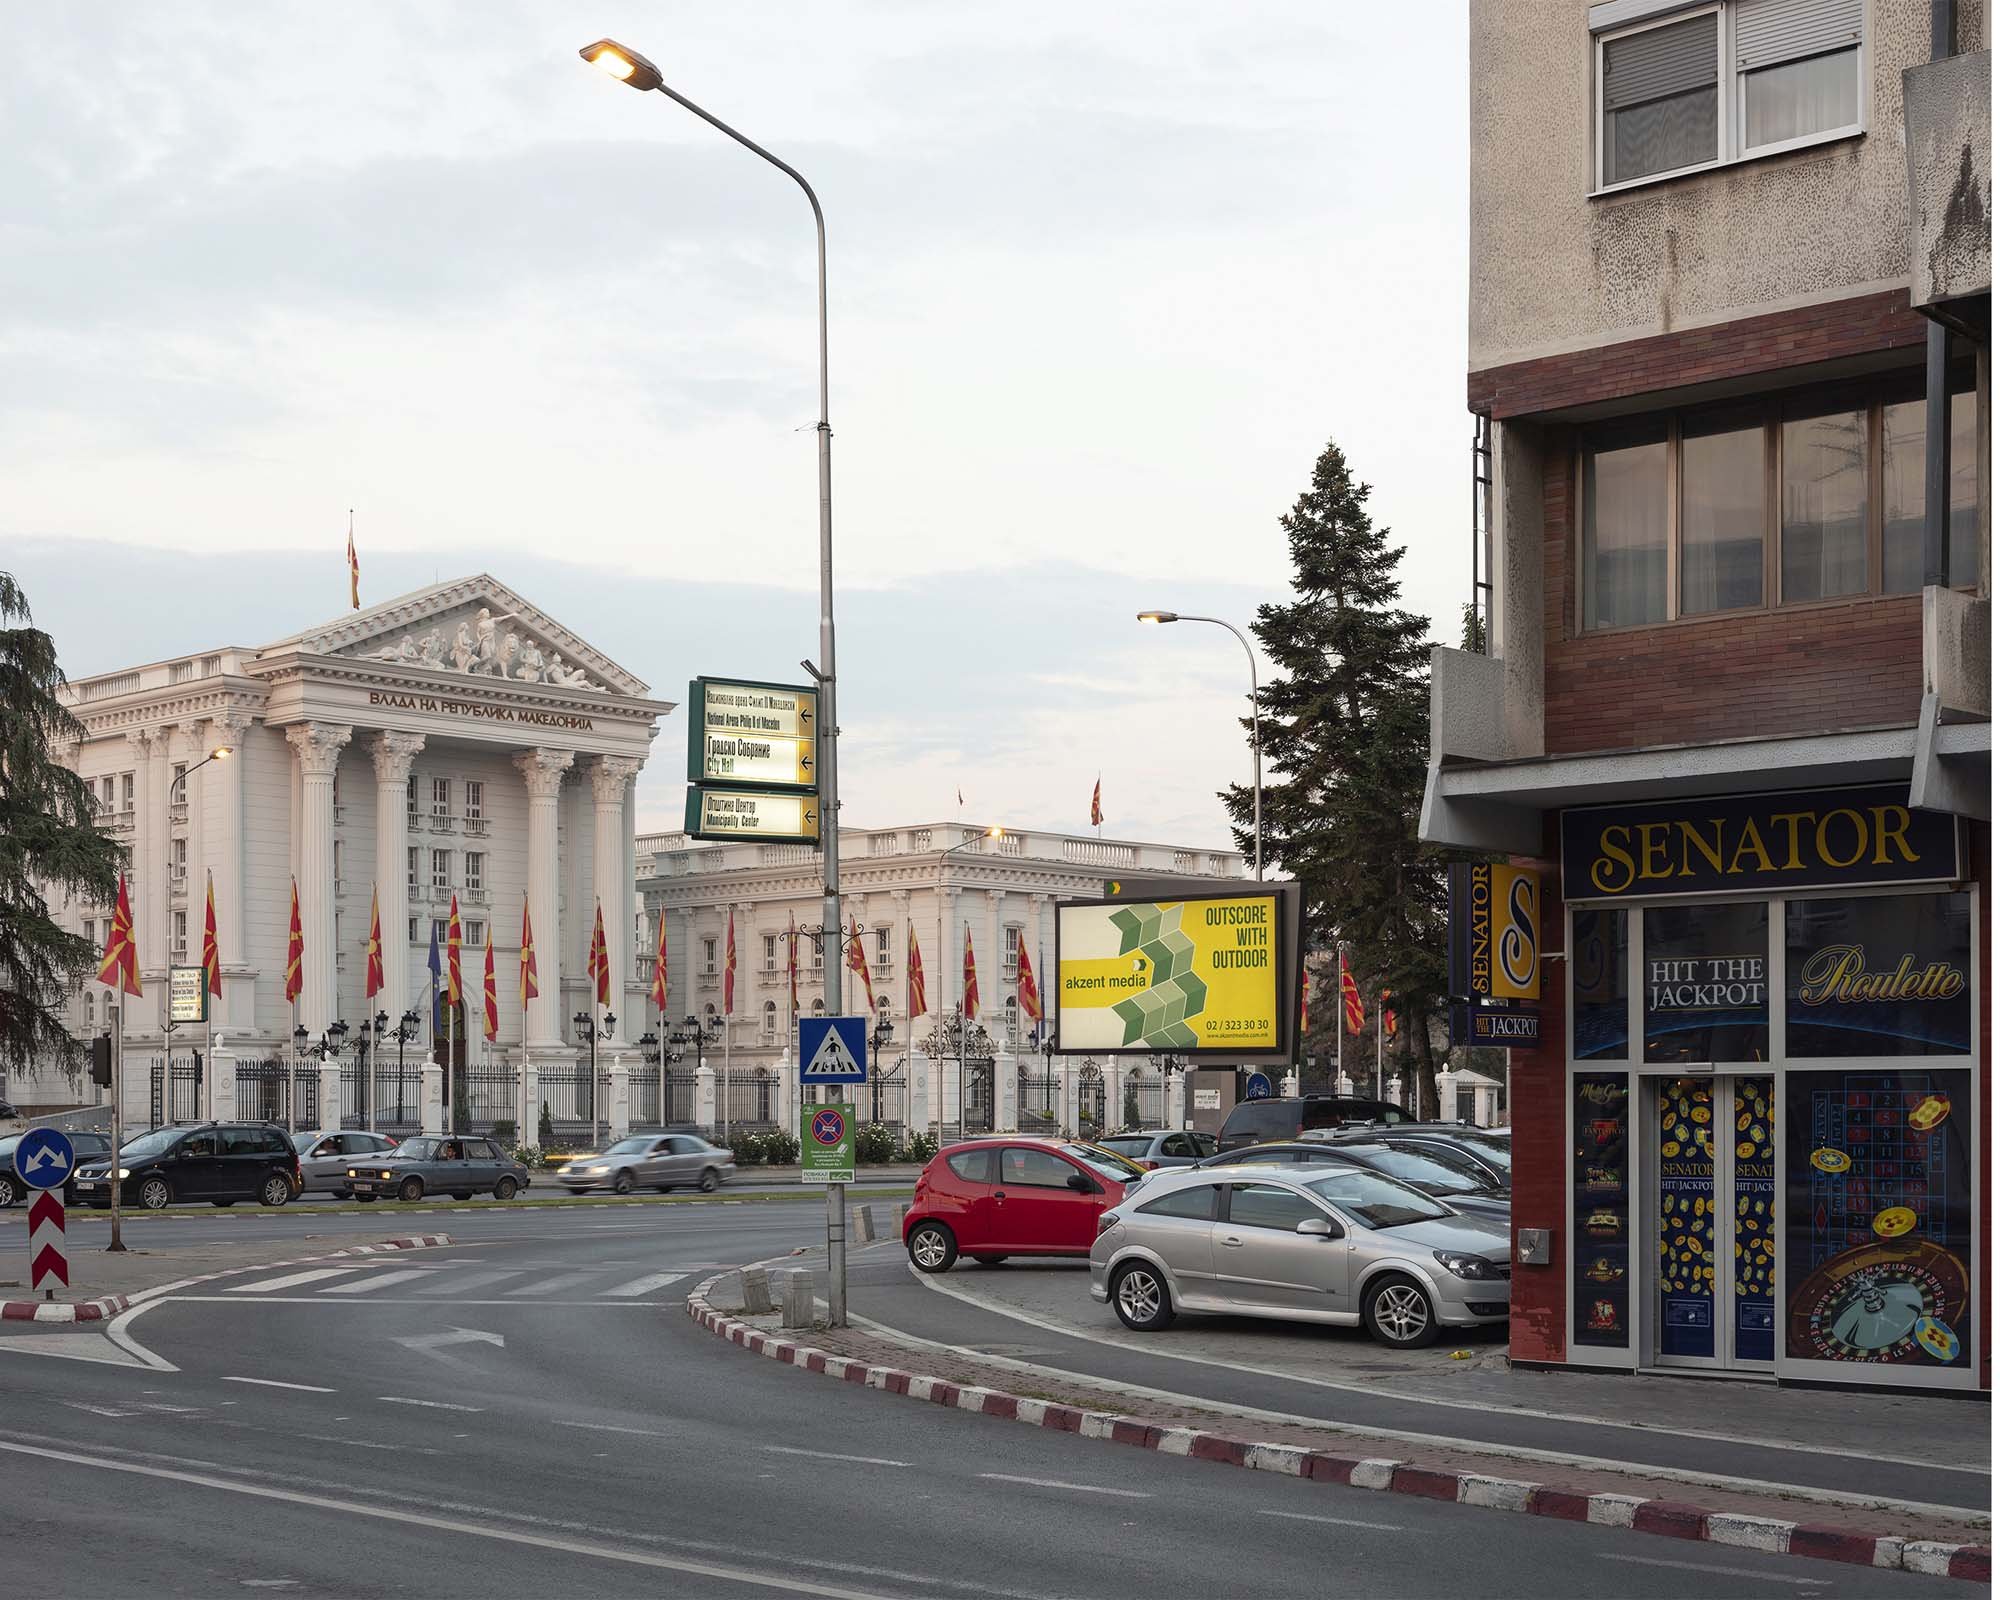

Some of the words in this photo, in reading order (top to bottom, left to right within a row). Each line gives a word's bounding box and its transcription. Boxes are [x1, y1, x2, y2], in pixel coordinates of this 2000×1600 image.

[369, 692, 416, 709] ВЛАДА
[420, 700, 438, 712] НА
[441, 701, 514, 721] РЕПУБЛИКА
[518, 711, 593, 731] МАКЕДОНИЈА
[707, 736, 736, 758] Градско
[737, 738, 771, 760] Собрание
[707, 756, 720, 775] City
[722, 757, 734, 773] Hall
[707, 796, 734, 813] Општина
[735, 797, 756, 816] Центар
[706, 813, 739, 829] Municipality
[741, 815, 759, 828] Center
[1591, 804, 1921, 893] SENATOR
[1206, 905, 1267, 926] OUTSCORE
[1236, 927, 1267, 946] WITH
[1471, 864, 1490, 994] SENATOR
[1212, 949, 1268, 969] OUTDOOR
[1650, 960, 1700, 983] HIT
[1707, 958, 1764, 981] THE
[1800, 944, 1964, 1007] Roulette
[1065, 975, 1106, 989] akzent
[1108, 973, 1146, 988] media
[1649, 983, 1764, 1011] JACKPOT
[1206, 1020, 1217, 1030] 02
[1225, 1020, 1242, 1030] 323
[1244, 1019, 1255, 1030] 30
[1257, 1019, 1269, 1029] 30
[1476, 1017, 1489, 1025] HIT
[1491, 1016, 1538, 1037] JACKPOT
[1883, 1095, 1890, 1105] 2
[1662, 1162, 1713, 1176] SENATOR
[1661, 1180, 1676, 1190] HIT
[1679, 1180, 1713, 1191] JACKPOT
[1736, 1182, 1750, 1191] HIT
